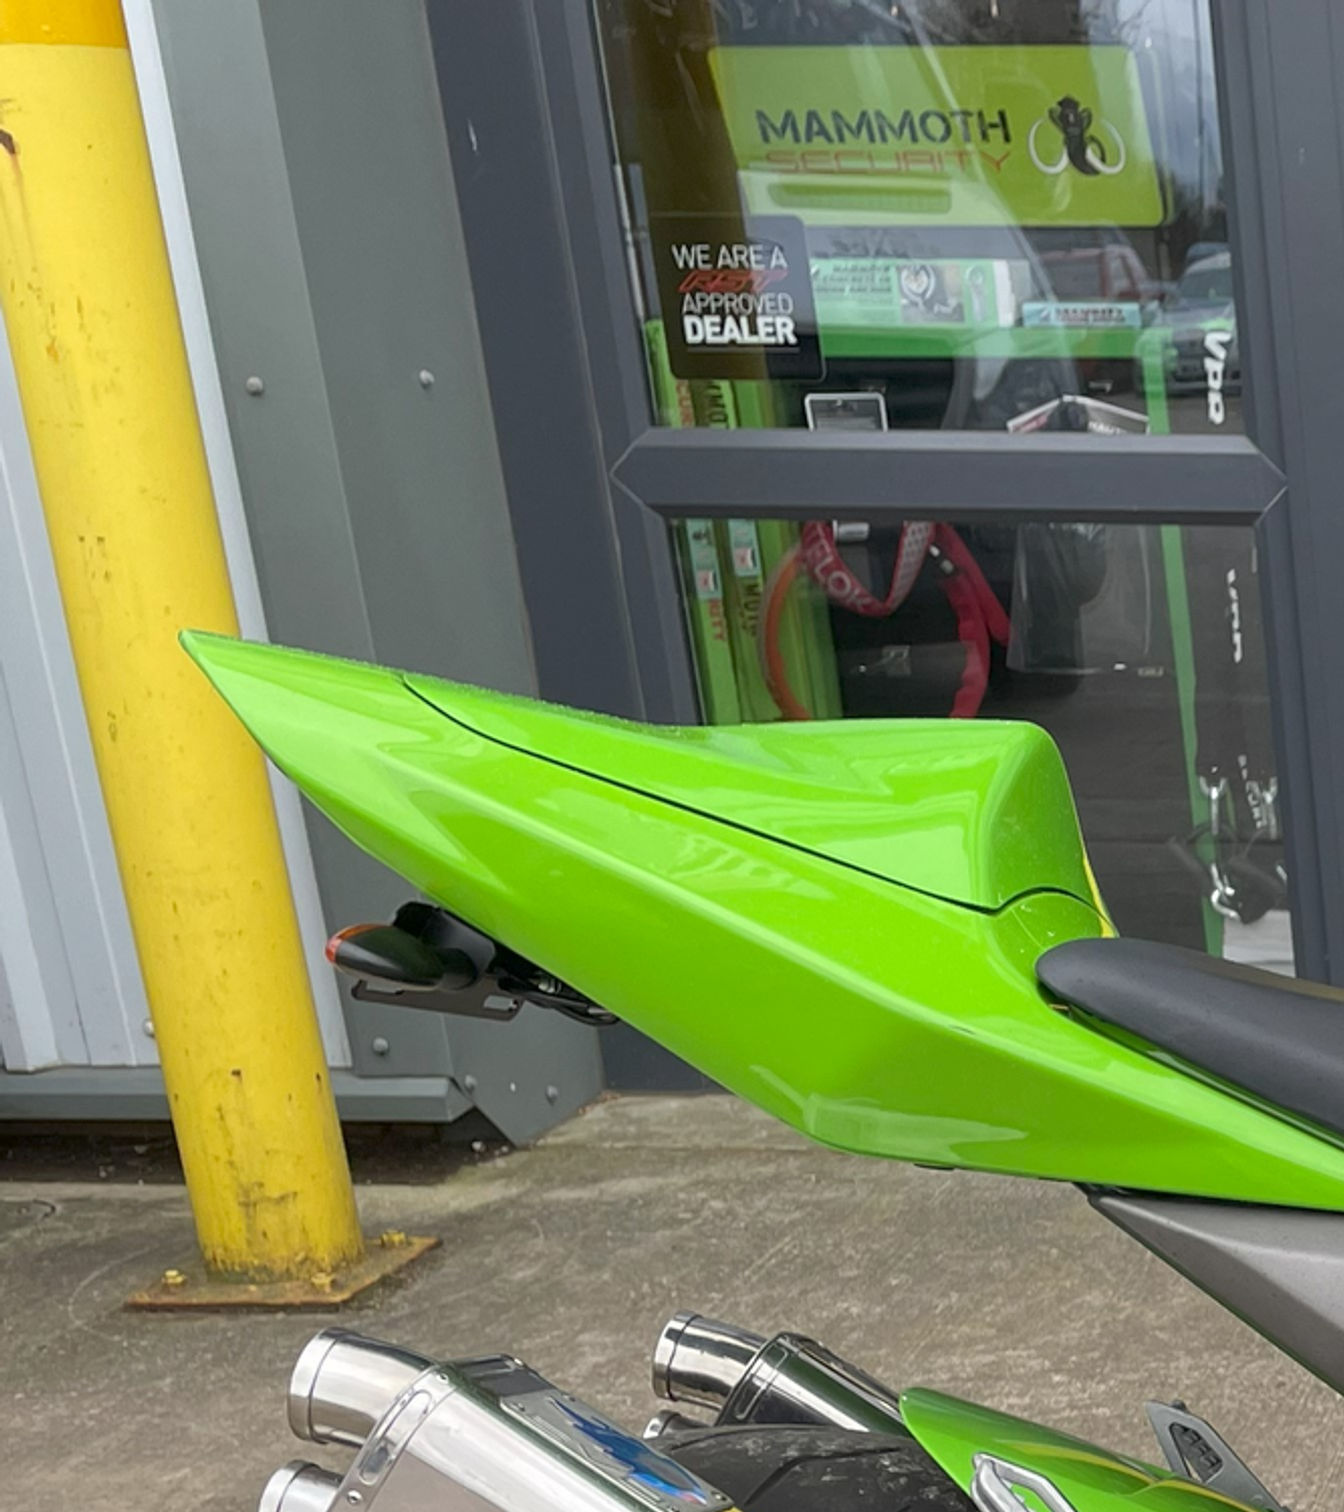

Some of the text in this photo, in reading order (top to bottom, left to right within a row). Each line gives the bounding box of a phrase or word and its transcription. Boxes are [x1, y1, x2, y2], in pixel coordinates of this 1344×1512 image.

[755, 109, 1012, 144] MAMMOTH
[765, 150, 1012, 174] SECURITY
[671, 243, 788, 270] WE ARE A
[682, 292, 794, 315] APPROVED
[683, 314, 798, 345] DEALER
